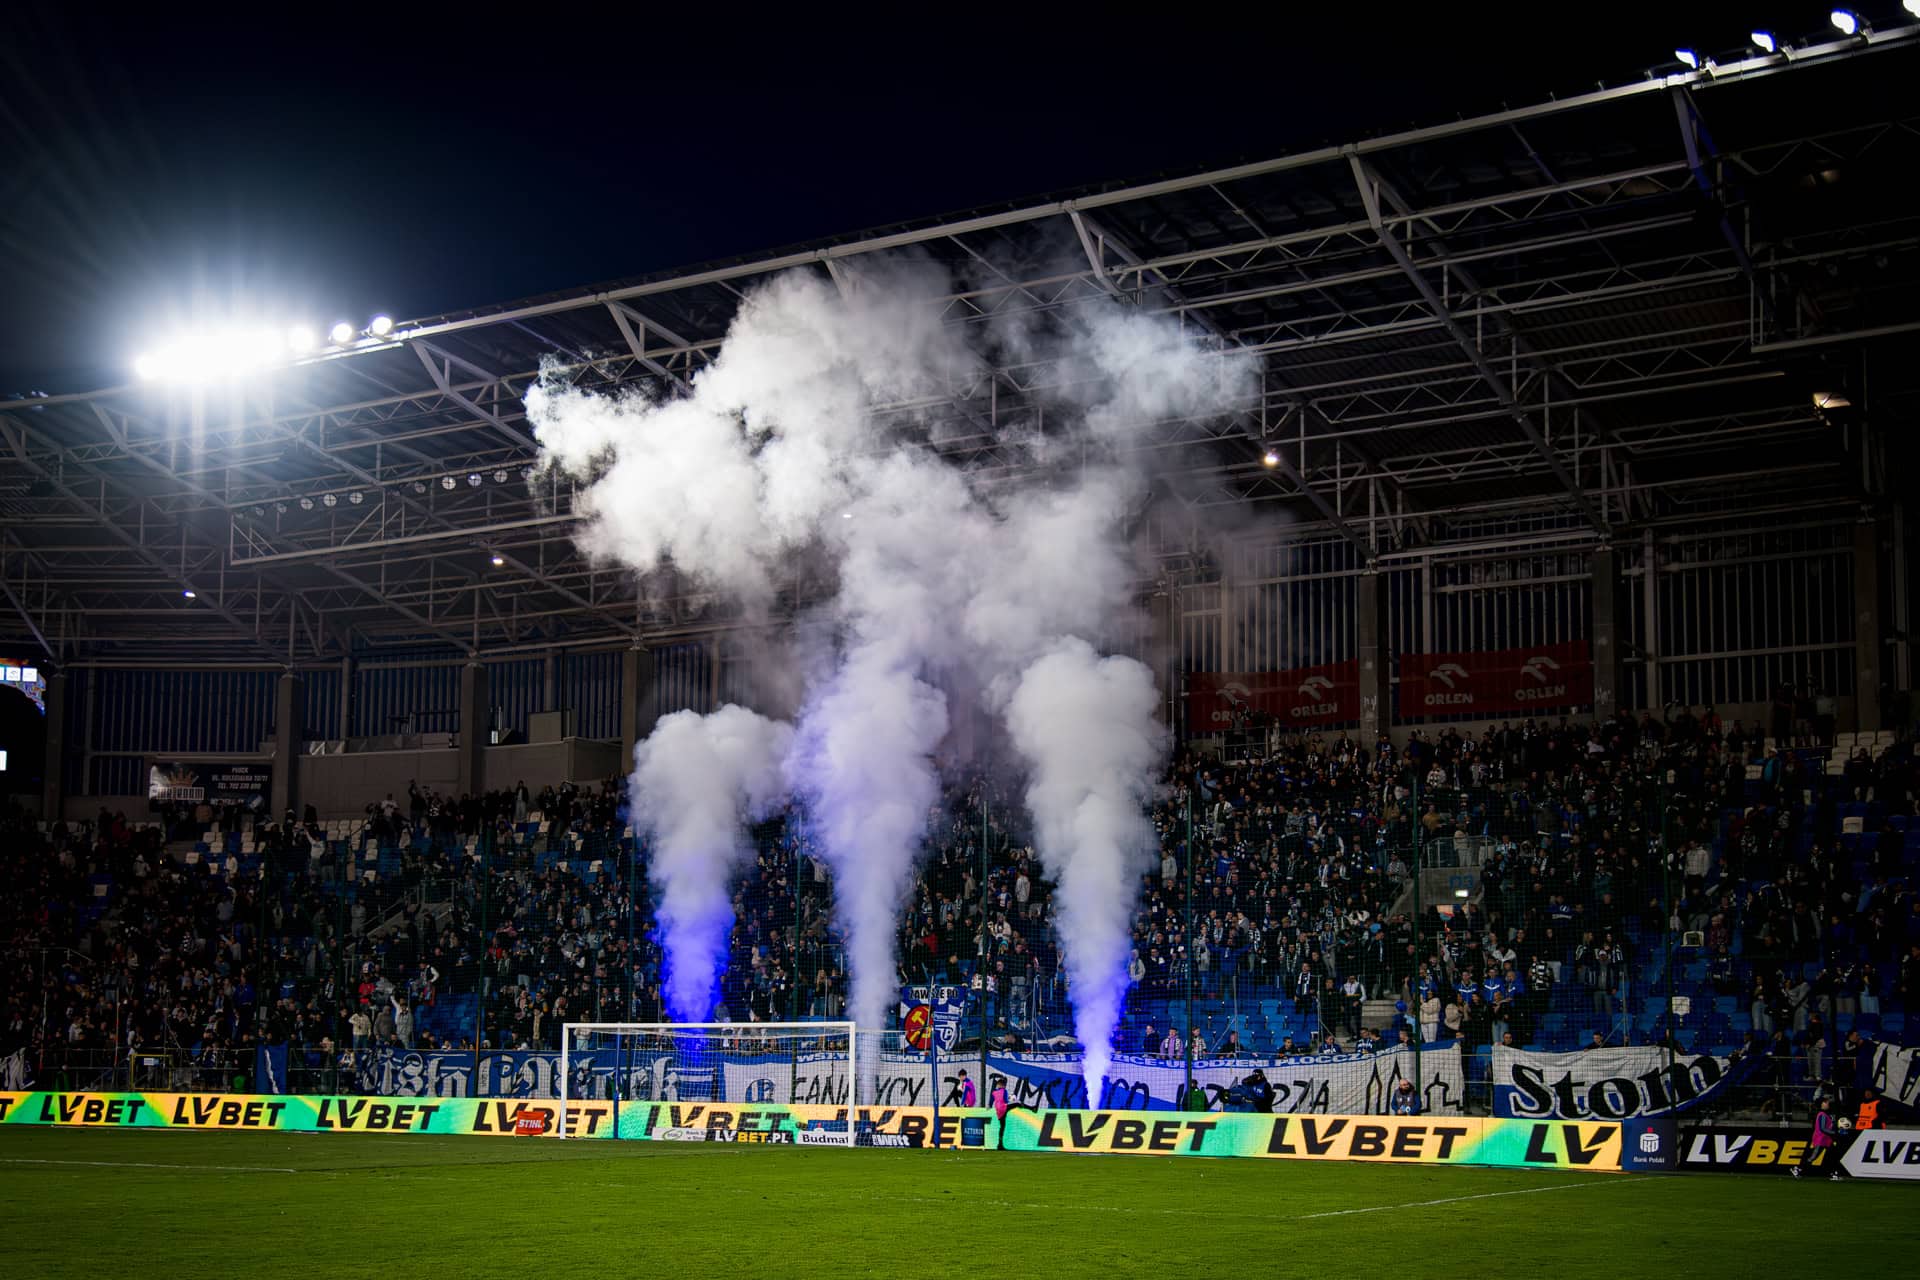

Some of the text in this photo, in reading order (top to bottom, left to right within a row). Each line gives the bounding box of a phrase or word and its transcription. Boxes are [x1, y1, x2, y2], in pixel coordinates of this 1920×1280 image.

[1425, 693, 1473, 705] ORLEN
[1514, 686, 1566, 701] ORLEN
[1290, 702, 1337, 717] ORLEN
[40, 1095, 145, 1124] LVBET
[173, 1095, 286, 1127] LVBET
[317, 1099, 440, 1130] LVBET
[519, 1119, 543, 1129] STIHL
[1037, 1113, 1216, 1151] LVBET
[1267, 1118, 1467, 1159] LVBET
